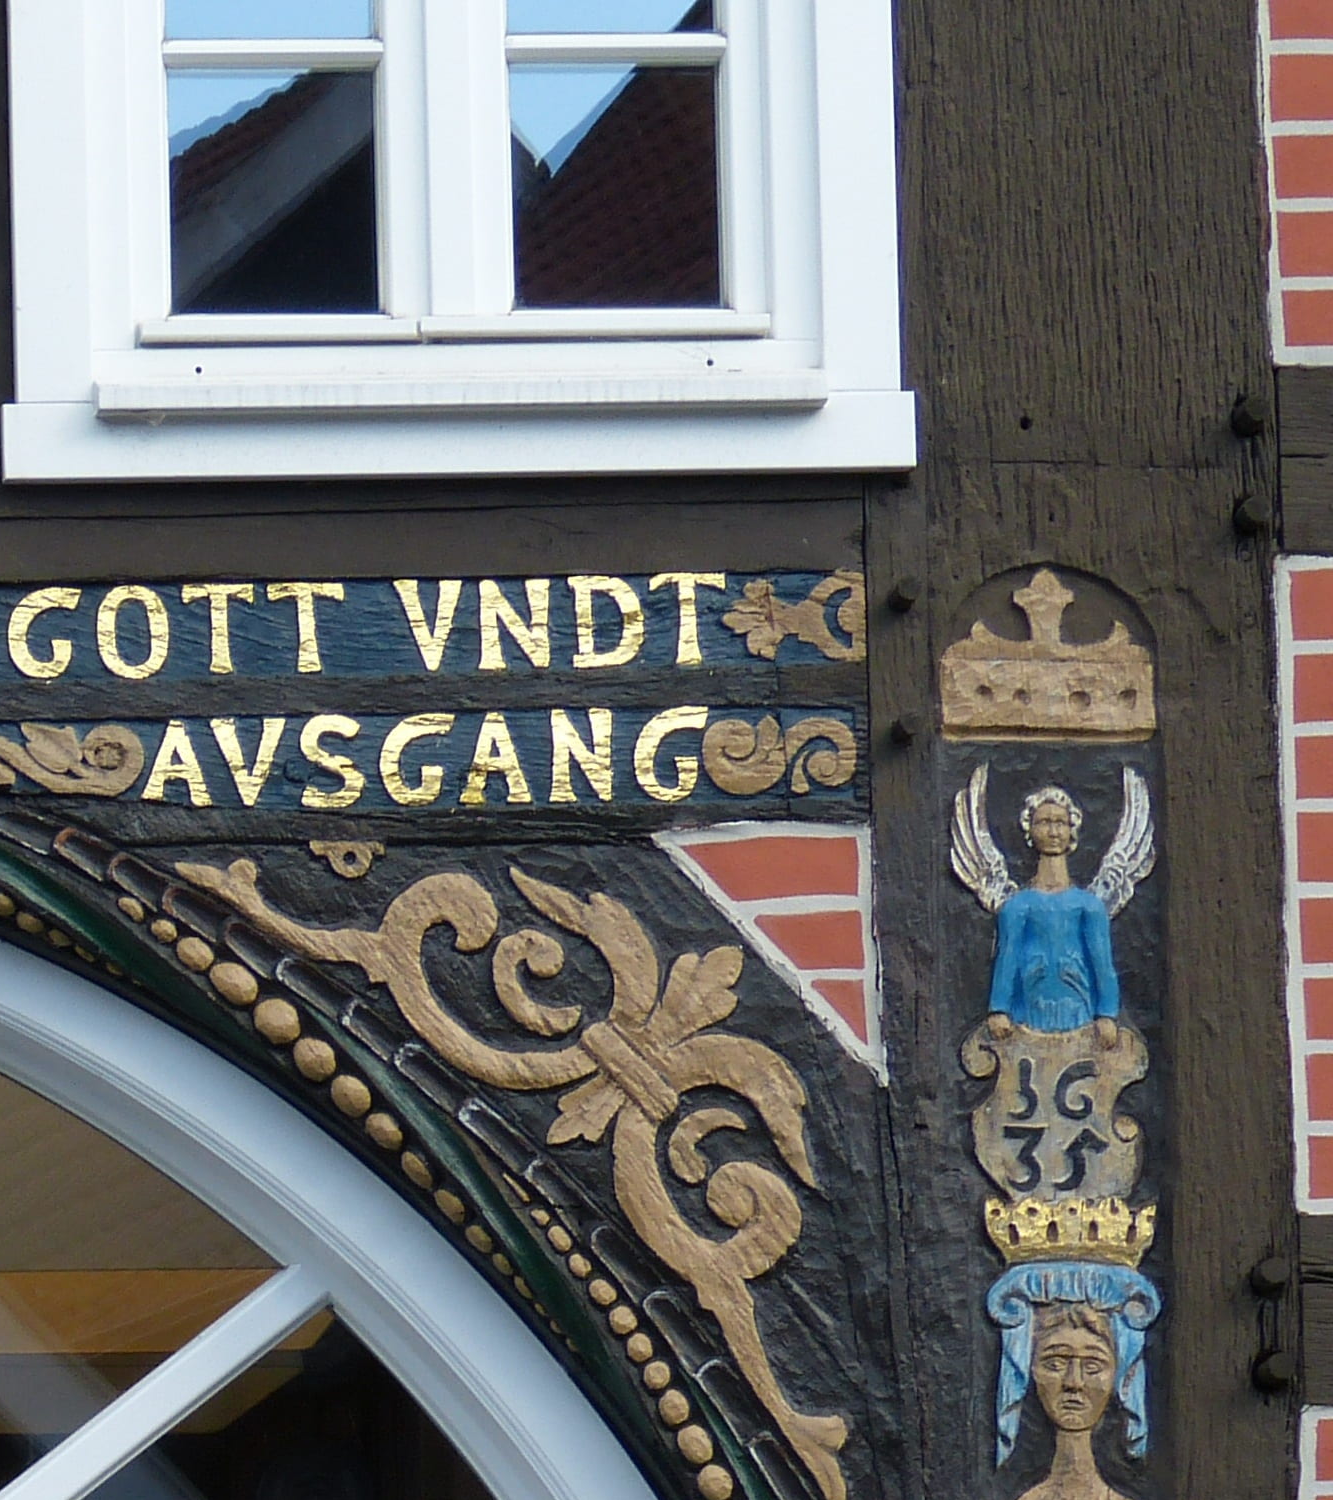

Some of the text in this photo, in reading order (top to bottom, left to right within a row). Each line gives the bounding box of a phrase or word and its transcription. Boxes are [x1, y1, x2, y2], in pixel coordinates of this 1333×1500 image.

[9, 583, 344, 679] GOTT
[394, 573, 725, 670] VNDT
[142, 706, 708, 807] AVSGANG
